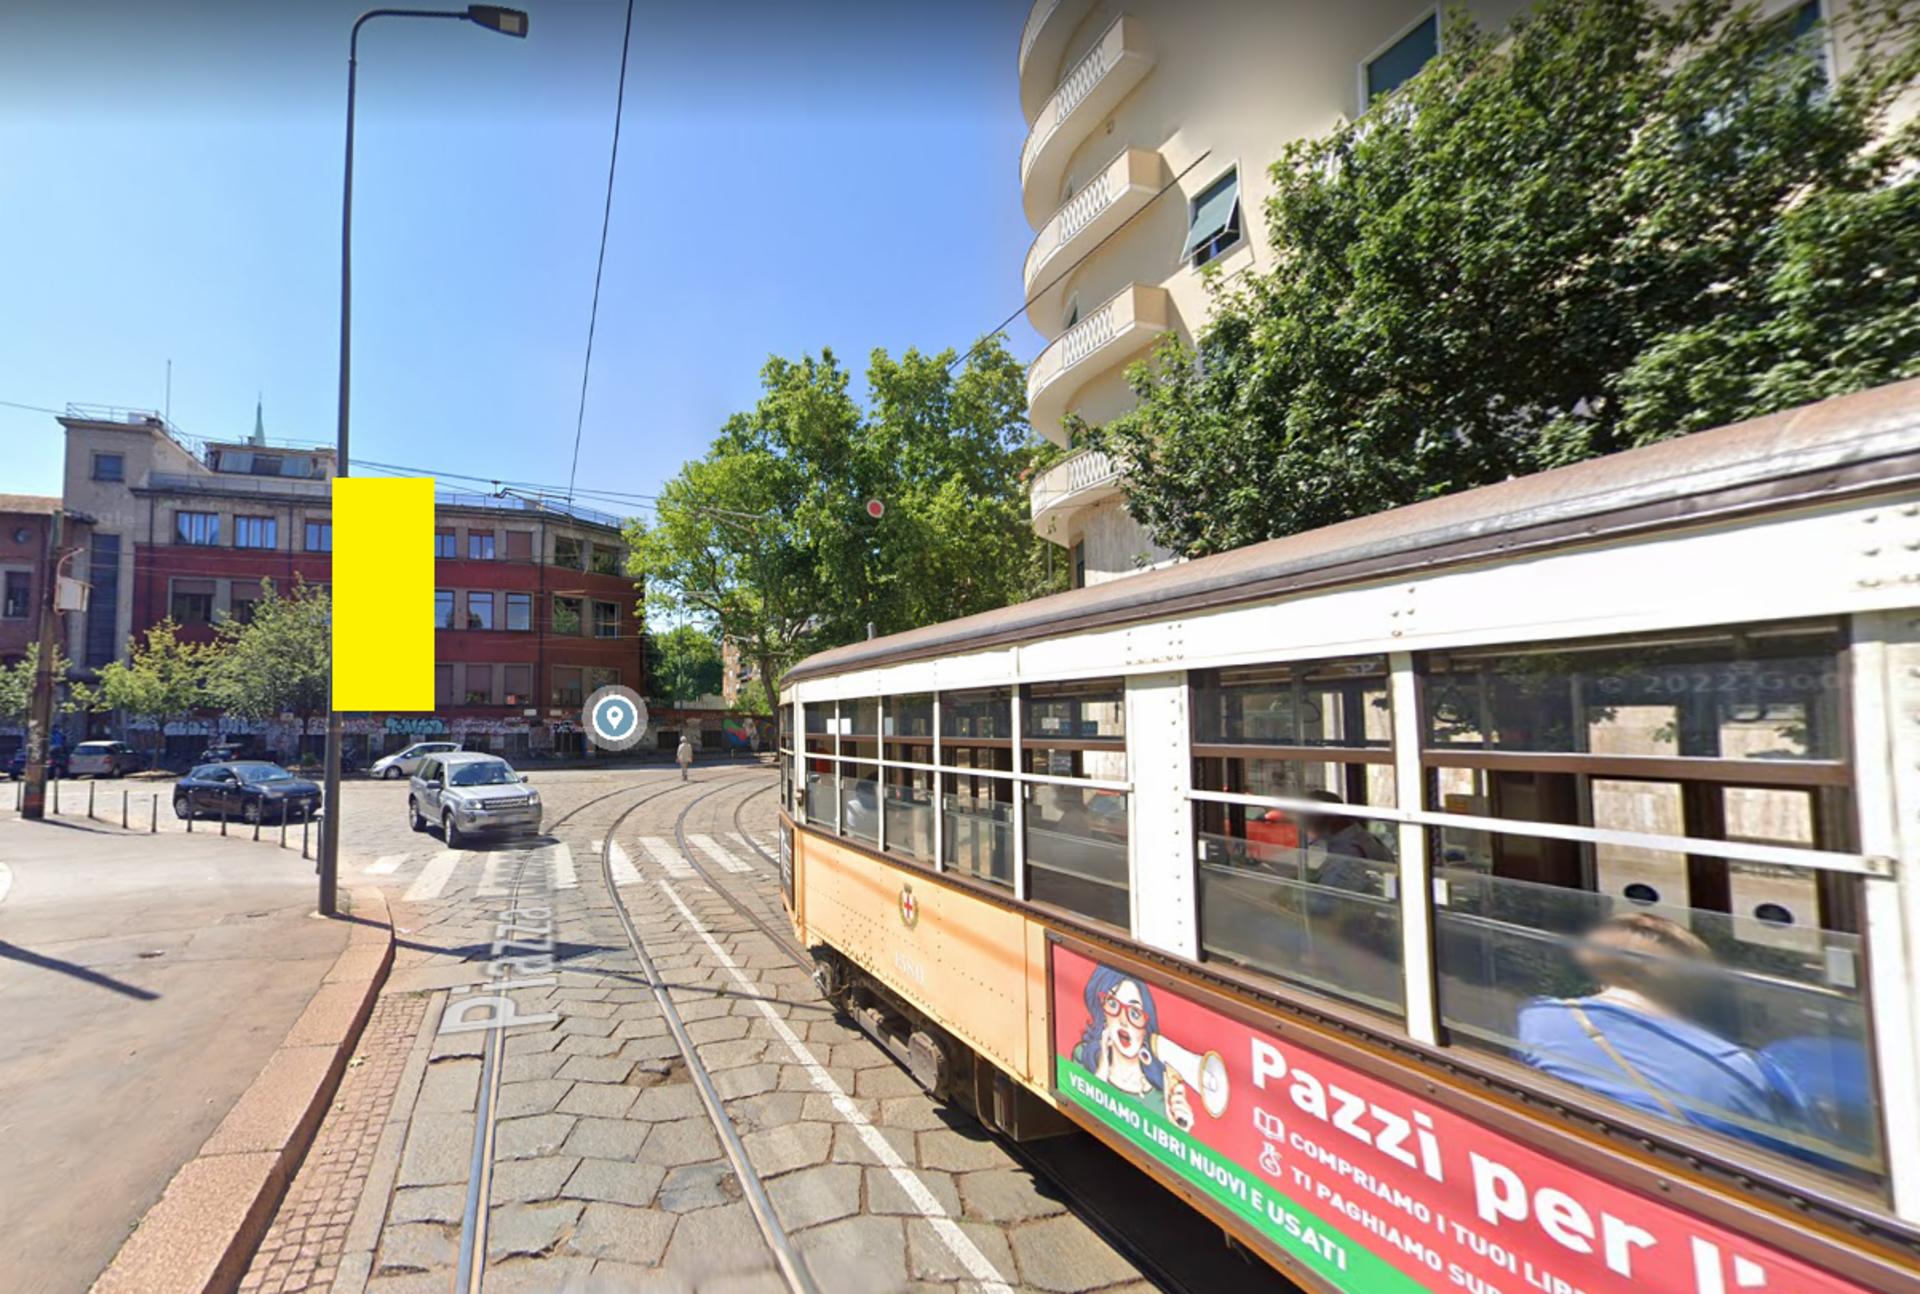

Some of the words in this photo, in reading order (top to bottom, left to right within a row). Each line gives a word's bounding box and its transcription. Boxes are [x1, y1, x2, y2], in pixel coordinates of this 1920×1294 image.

[1069, 1071, 1140, 1129] VENDIAMO
[1143, 1119, 1187, 1161] LIBRI
[1190, 1148, 1247, 1201] NUOVI
[1250, 1190, 1263, 1212] E
[1266, 1201, 1348, 1271] USATI
[1251, 1037, 1443, 1183] Pazzi
[1469, 1151, 1658, 1279] per
[1290, 1132, 1431, 1224] COMPRIAMO
[1436, 1213, 1446, 1235] I
[1450, 1221, 1518, 1275] TUOI
[1523, 1261, 1588, 1294] LIB
[1290, 1166, 1312, 1192] TI
[1316, 1181, 1443, 1272] PAGHIAMO
